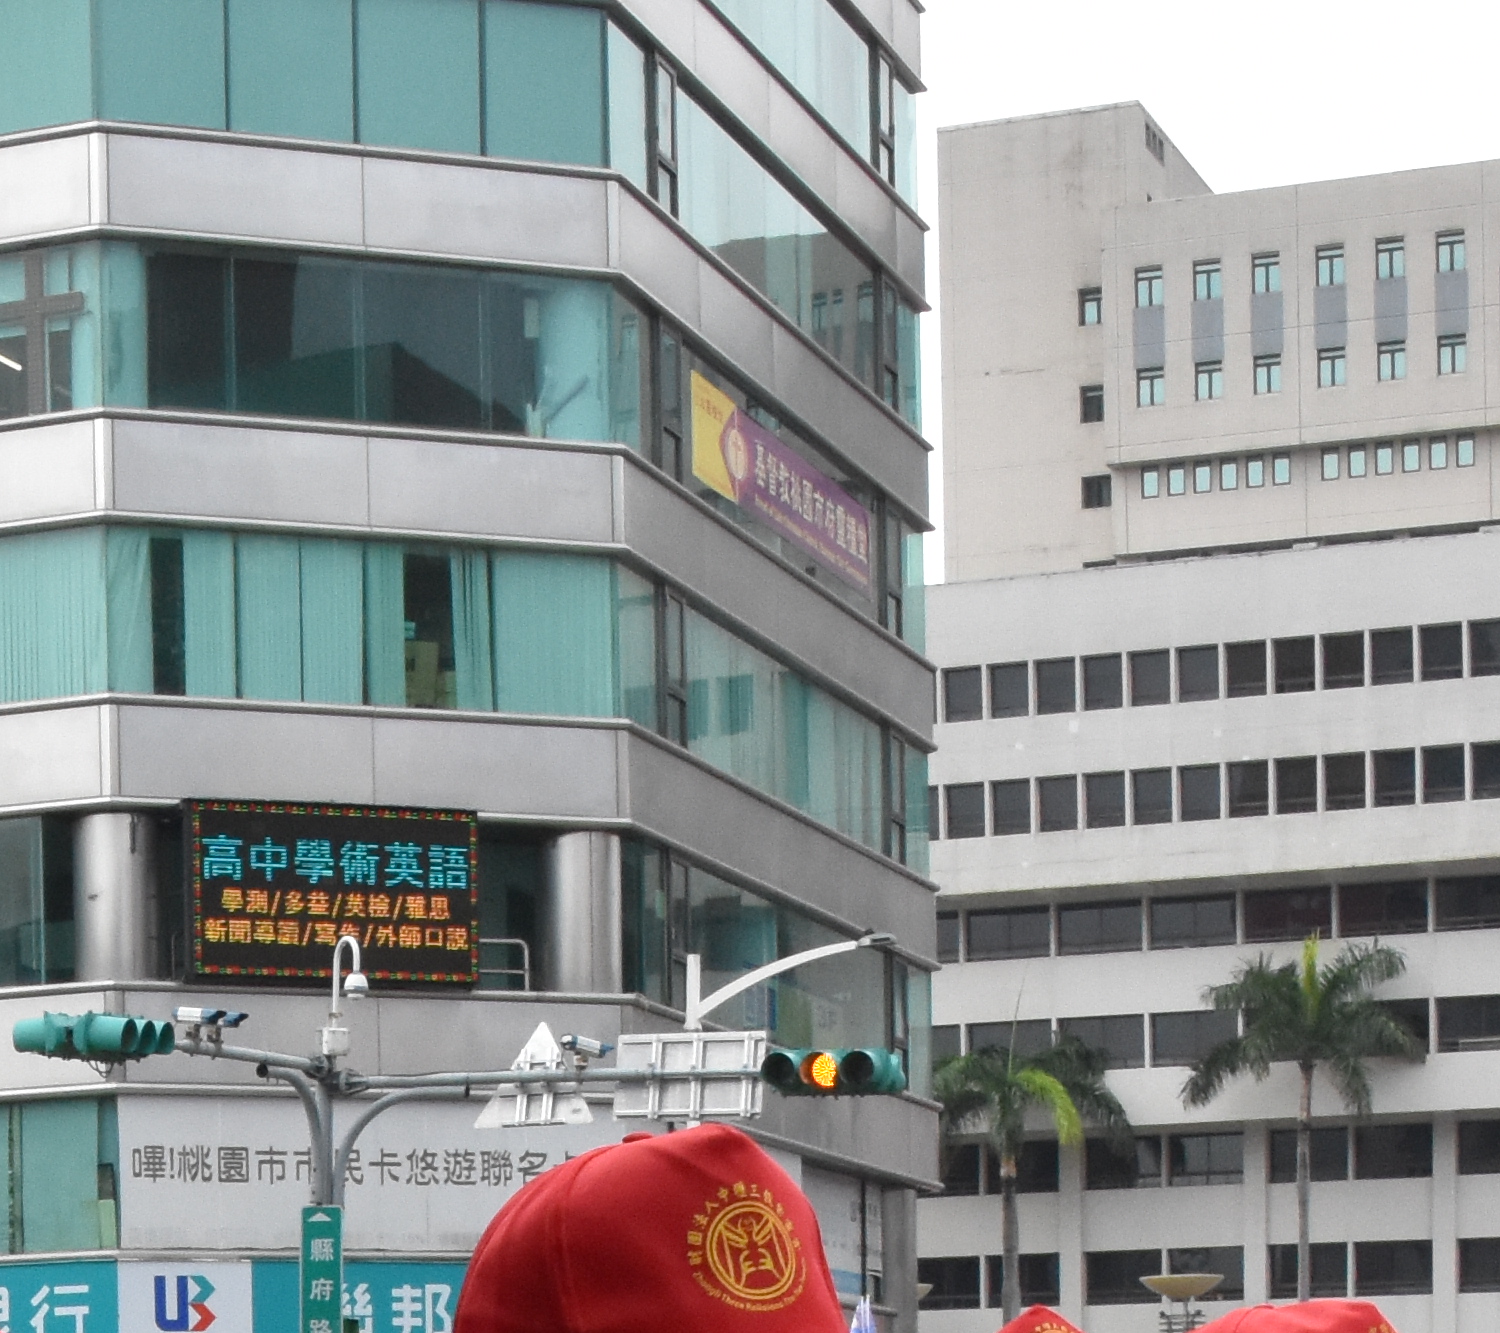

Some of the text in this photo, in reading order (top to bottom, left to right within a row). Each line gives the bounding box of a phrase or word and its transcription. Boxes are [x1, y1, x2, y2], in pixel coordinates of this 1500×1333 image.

[202, 834, 470, 890] 高中學術英語
